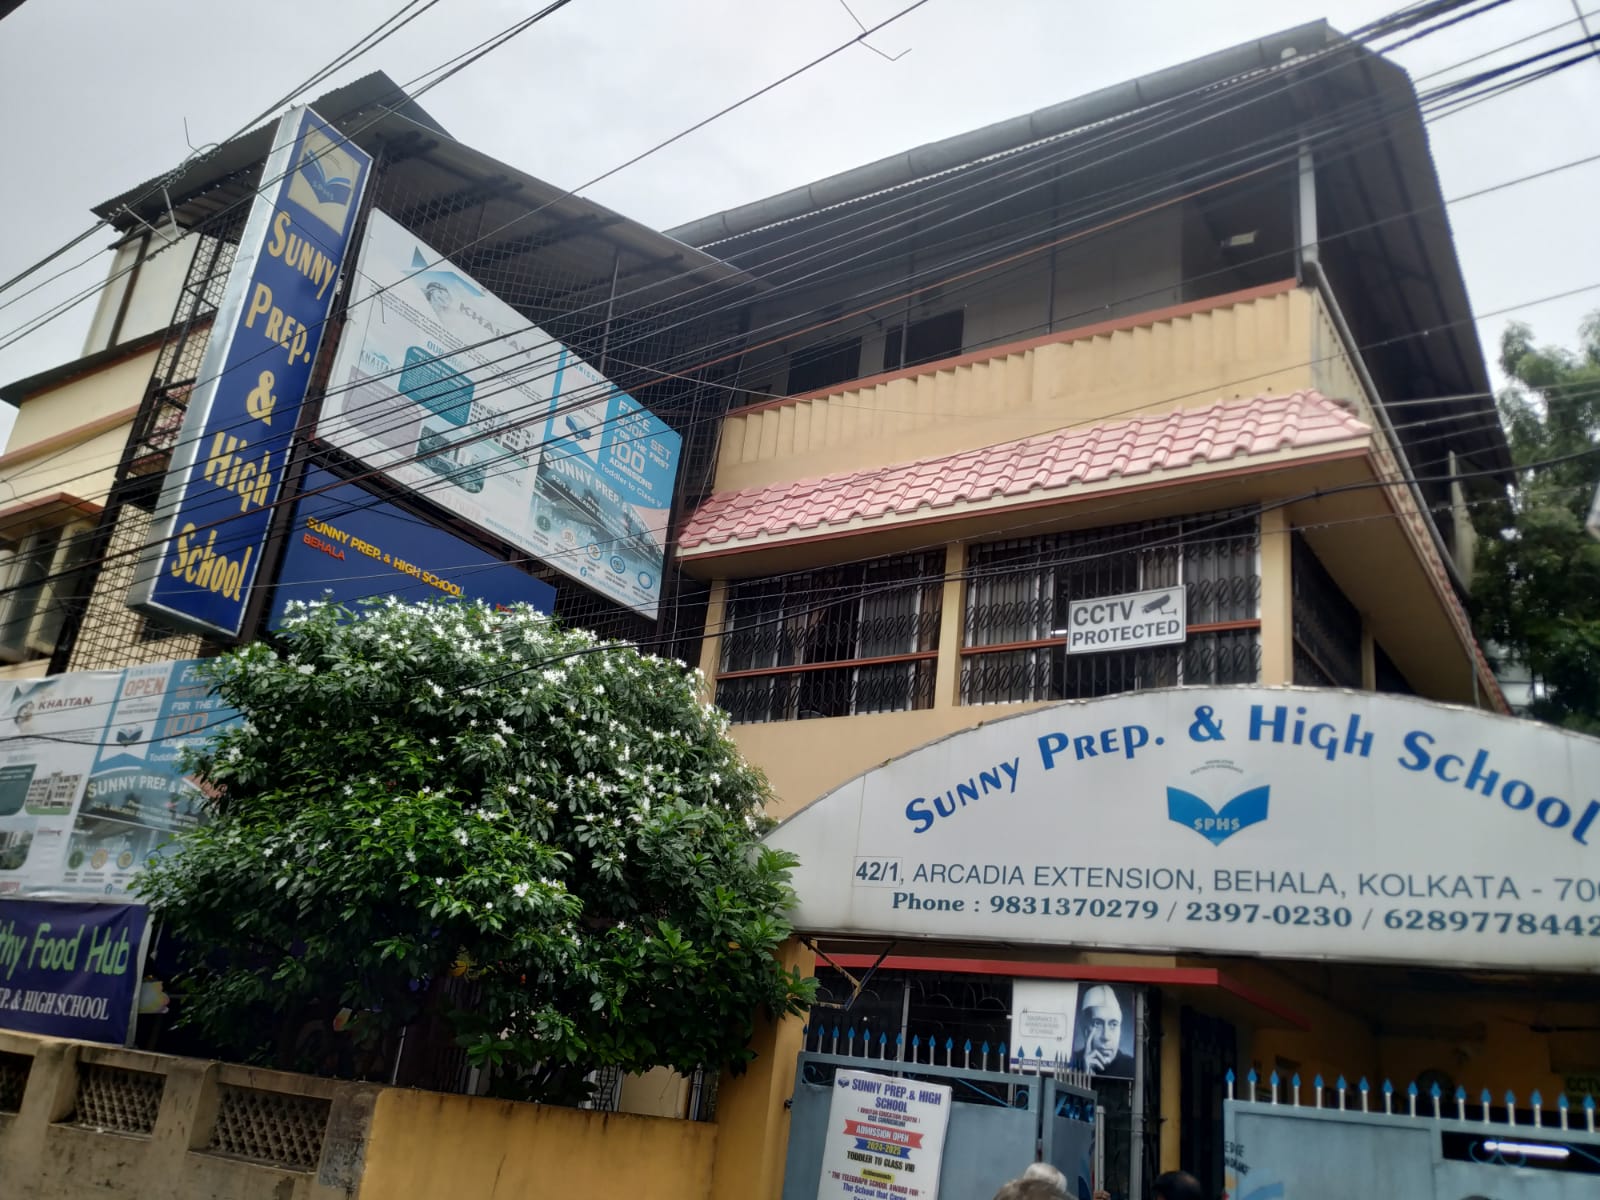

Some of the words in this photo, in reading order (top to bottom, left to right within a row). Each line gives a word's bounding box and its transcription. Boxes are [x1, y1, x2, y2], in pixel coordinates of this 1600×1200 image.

[246, 369, 277, 426] &
[617, 398, 650, 432] FREE
[610, 434, 645, 475] 100
[614, 425, 631, 443] FOR
[633, 439, 647, 455] THE
[648, 451, 669, 471] FIRST
[649, 437, 671, 461] SET
[541, 445, 591, 492] SUNNY
[593, 478, 621, 506] PREP.
[600, 462, 627, 485] Toddler
[627, 480, 635, 492] to
[609, 455, 653, 491] ADMISSIONS
[303, 533, 346, 561] BEHALA
[306, 516, 350, 545] SUNNY
[350, 536, 381, 561] PREP.
[383, 553, 391, 564] &
[393, 556, 421, 579] HIGH
[421, 571, 464, 597] SCHOOL
[1073, 600, 1134, 626] CCTV
[1072, 619, 1181, 646] PROTECTED
[124, 677, 165, 697] OPEN
[38, 696, 93, 710] KHAITAN
[171, 701, 191, 711] FOR
[195, 700, 212, 710] THE
[164, 713, 208, 736] 100
[1188, 704, 1225, 743] &
[87, 776, 137, 798] SUNNY
[139, 775, 168, 791] PREP.
[1193, 817, 1241, 832] SPHS
[855, 861, 905, 886] 42/1,
[913, 863, 1025, 887] ARCADIA
[1034, 866, 1203, 895] EXTENSION,
[1214, 869, 1347, 899] BEHALA,
[1358, 873, 1521, 900] KOLKATA
[1553, 877, 1600, 903] 70
[892, 892, 965, 912] Phone
[990, 895, 1159, 919] 9831370279
[1166, 901, 1178, 923] /
[1186, 902, 1352, 928] 2397-0230
[1361, 908, 1373, 931] /
[28, 922, 85, 972] Food
[84, 926, 130, 976] Hub
[10, 989, 22, 1011] &
[22, 990, 59, 1014] HIGH
[54, 992, 110, 1021] SCHOOL
[851, 1077, 881, 1094] SUNNY
[918, 1090, 941, 1105] HIGH
[874, 1096, 908, 1112] SCHOOL
[855, 1123, 891, 1138] ADMISSION
[892, 1131, 909, 1142] OPEN
[846, 1150, 873, 1163] TODDLER
[873, 1156, 882, 1165] TO
[883, 1158, 903, 1169] CLASS
[842, 1182, 854, 1191] The
[853, 1185, 875, 1196] School
